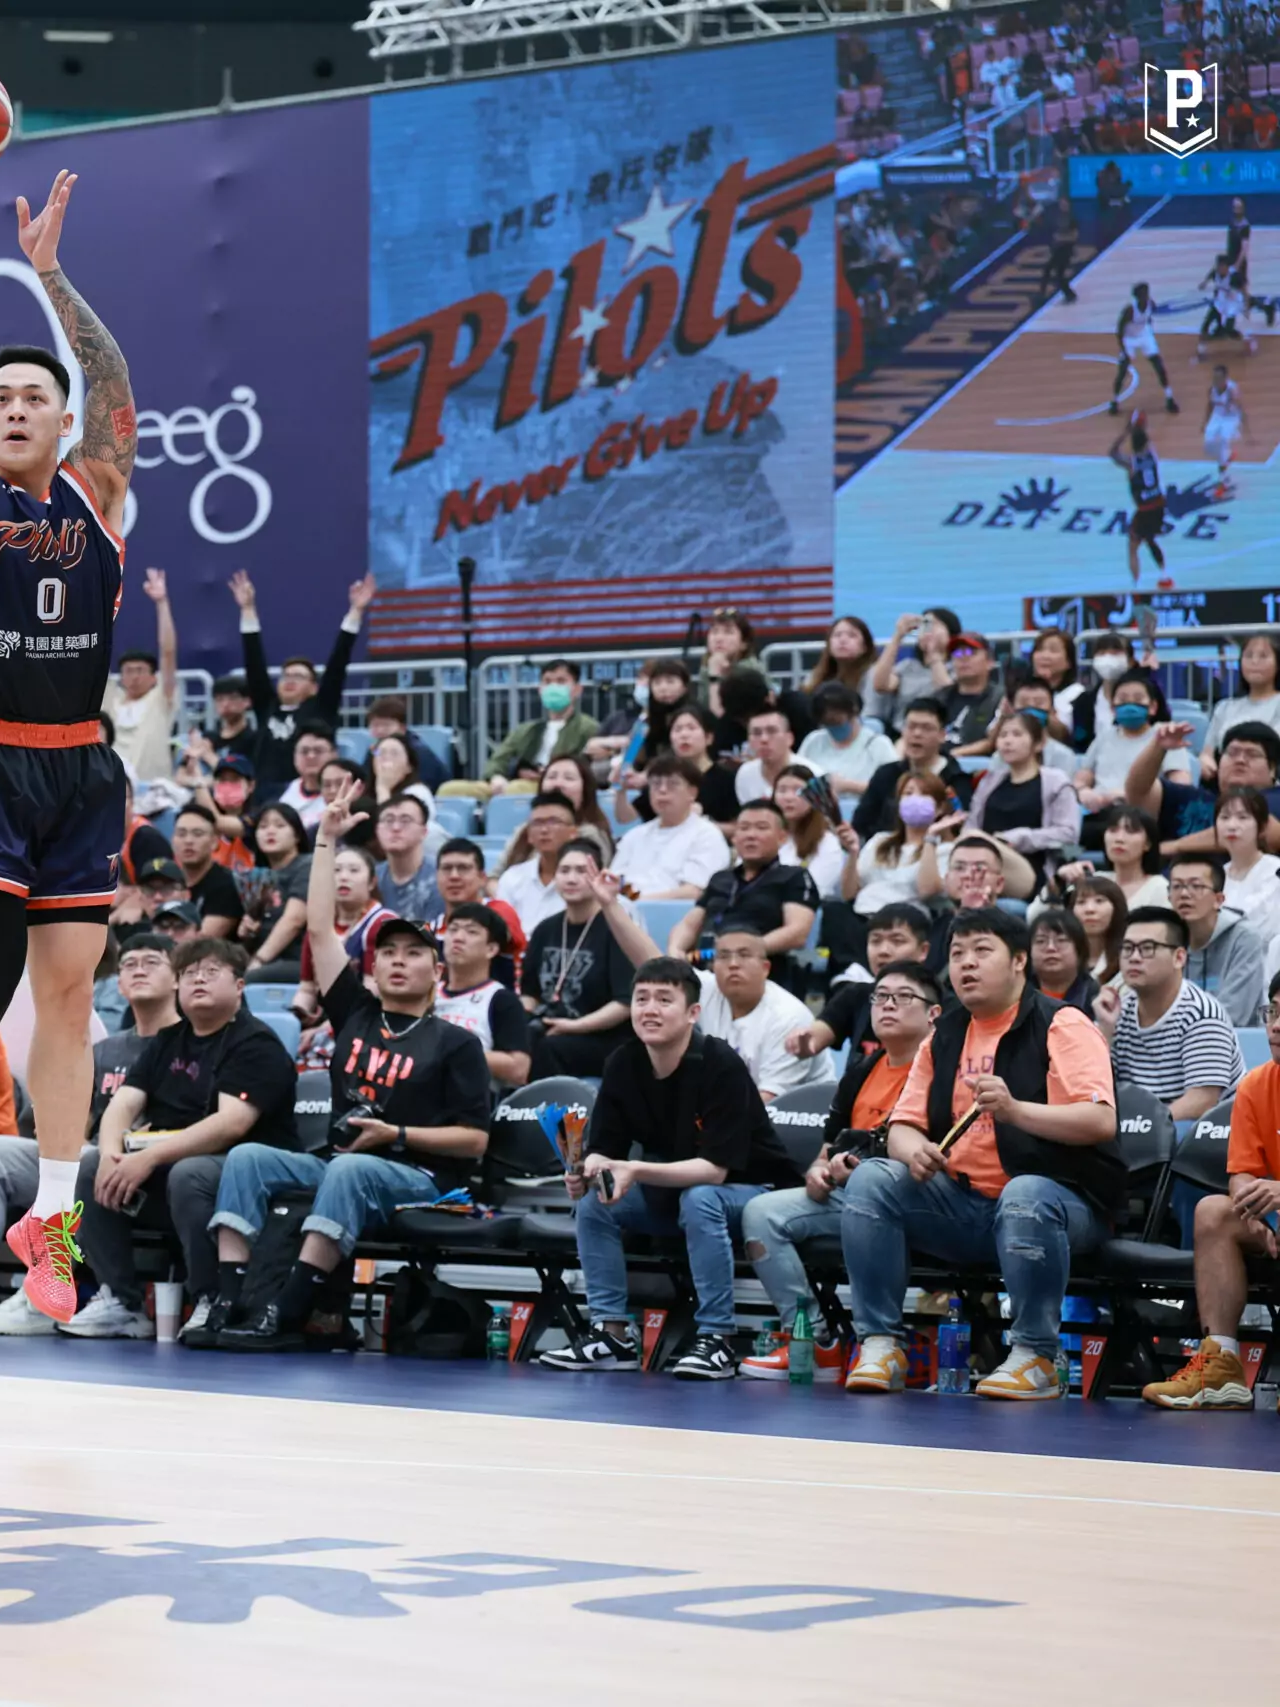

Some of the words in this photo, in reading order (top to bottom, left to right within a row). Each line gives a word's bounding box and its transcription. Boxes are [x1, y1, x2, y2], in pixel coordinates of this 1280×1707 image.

[369, 143, 835, 474] Pilots
[433, 456, 578, 542] Never
[583, 409, 698, 482] Give
[703, 370, 779, 438] Up
[36, 577, 66, 624] 0
[513, 1306, 531, 1321] 24
[646, 1313, 663, 1328] 23
[1084, 1340, 1103, 1356] 20
[1246, 1347, 1262, 1363] 19
